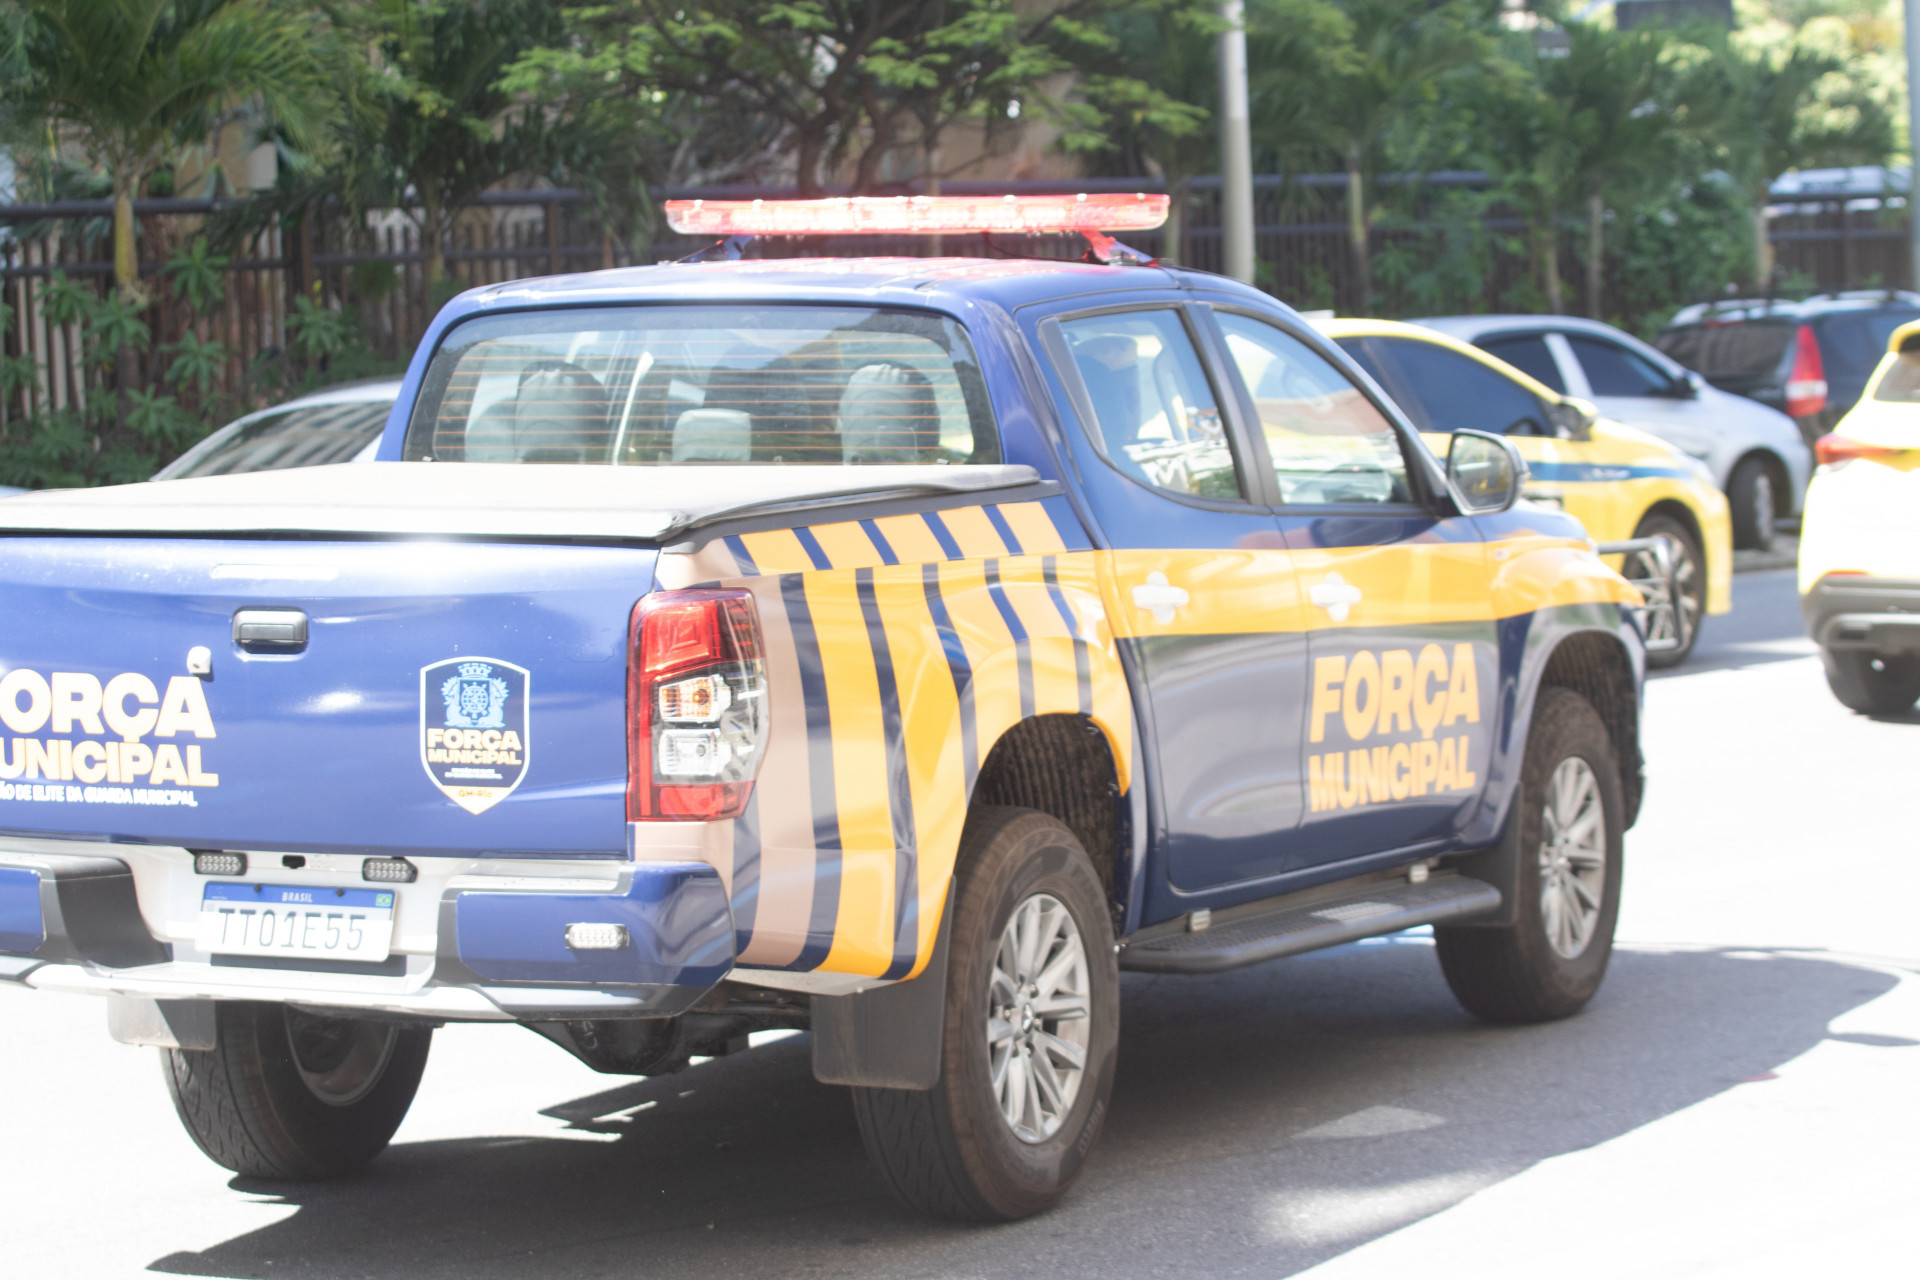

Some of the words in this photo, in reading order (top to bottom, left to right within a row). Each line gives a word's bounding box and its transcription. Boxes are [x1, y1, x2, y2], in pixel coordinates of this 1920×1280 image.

[0, 668, 217, 743] ORÇA
[1309, 642, 1481, 744] FORÇA
[427, 728, 522, 752] FORÇA
[427, 748, 522, 765] MUNICIPAL
[0, 737, 219, 787] UNICIPAL
[1308, 735, 1476, 813] MUNICIPAL
[15, 784, 32, 800] DE
[32, 785, 65, 802] ELITE
[65, 785, 84, 802] DA
[132, 788, 198, 807] MUNICIPAL
[281, 891, 313, 903] BRASIL
